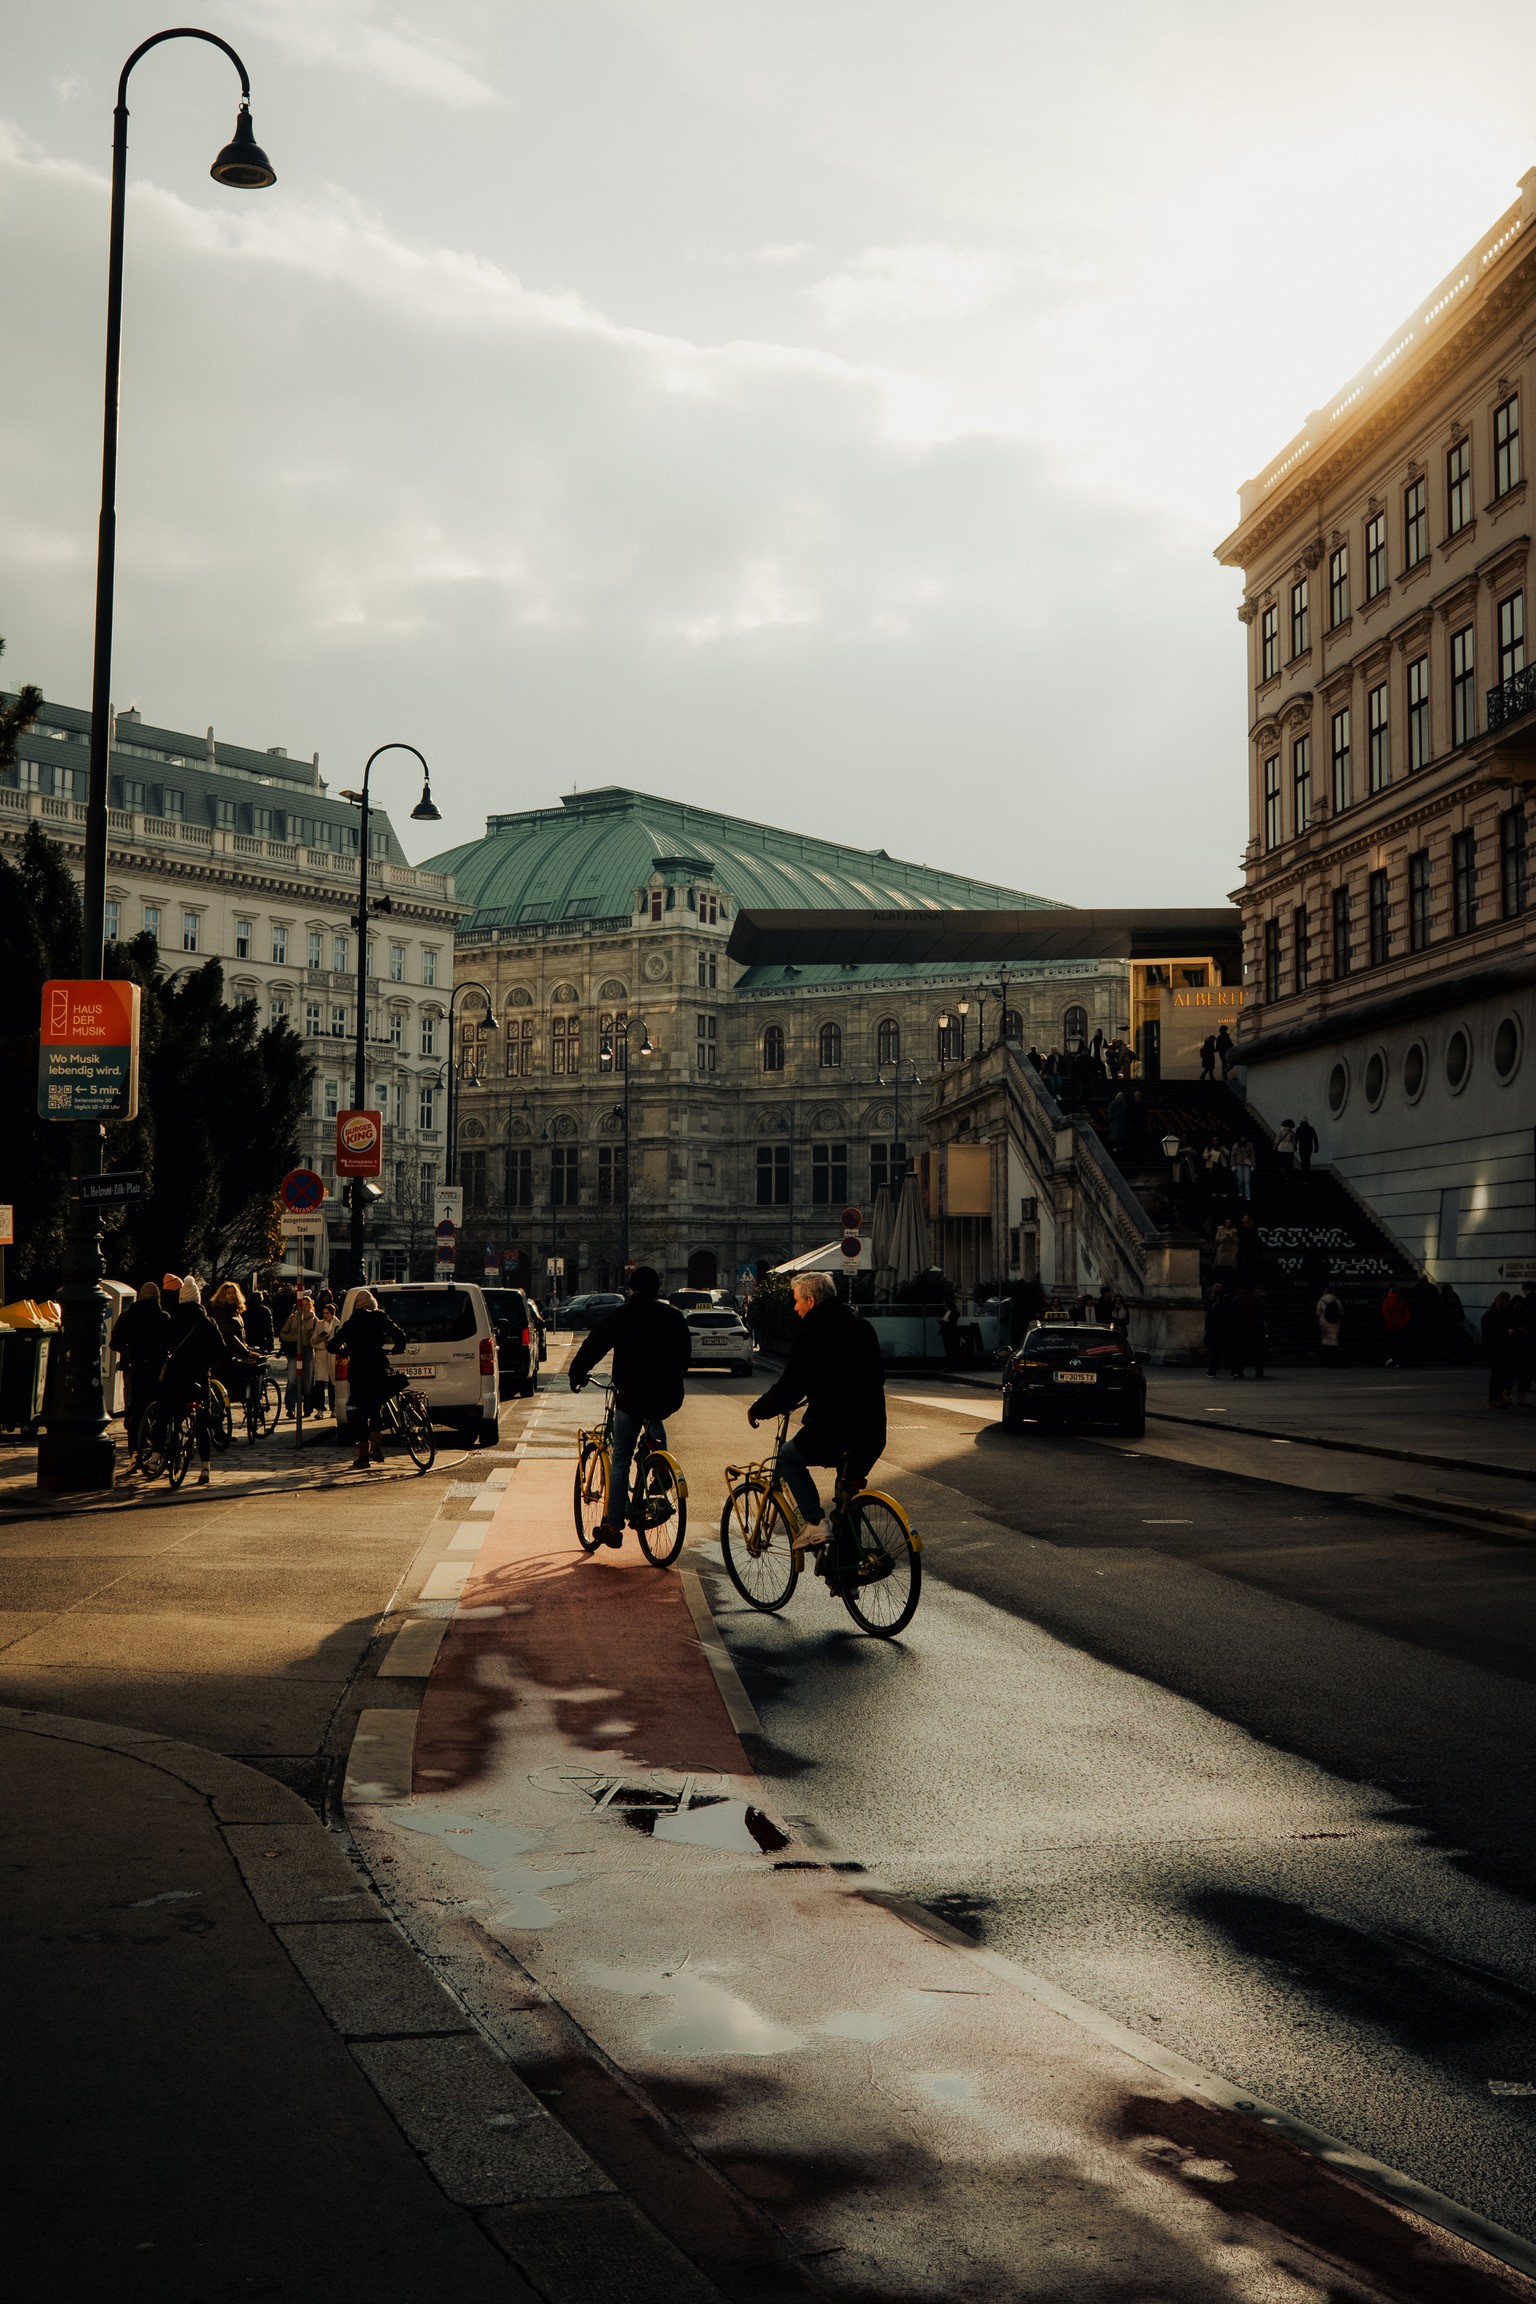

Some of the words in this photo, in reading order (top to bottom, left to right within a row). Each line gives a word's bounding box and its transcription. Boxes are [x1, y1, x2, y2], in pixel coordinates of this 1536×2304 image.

[872, 911, 942, 921] ALBERTINA
[1173, 991, 1248, 1007] ALBERTI
[73, 1004, 103, 1014] HAUS
[73, 1015, 95, 1025] DER
[72, 1026, 106, 1036] MUSIK
[49, 1054, 68, 1064] Wo
[69, 1054, 100, 1064] Musik
[49, 1065, 94, 1078] lebendig
[95, 1065, 122, 1075] wird.
[90, 1085, 98, 1095] 5
[99, 1085, 121, 1095] min.
[345, 1123, 372, 1136] BURGER
[346, 1130, 373, 1144] KING
[291, 1204, 315, 1213] ANFANG
[283, 1217, 322, 1225] ausgenommen
[1257, 1227, 1357, 1248] GOTHIC
[1069, 1373, 1085, 1381] 3015
